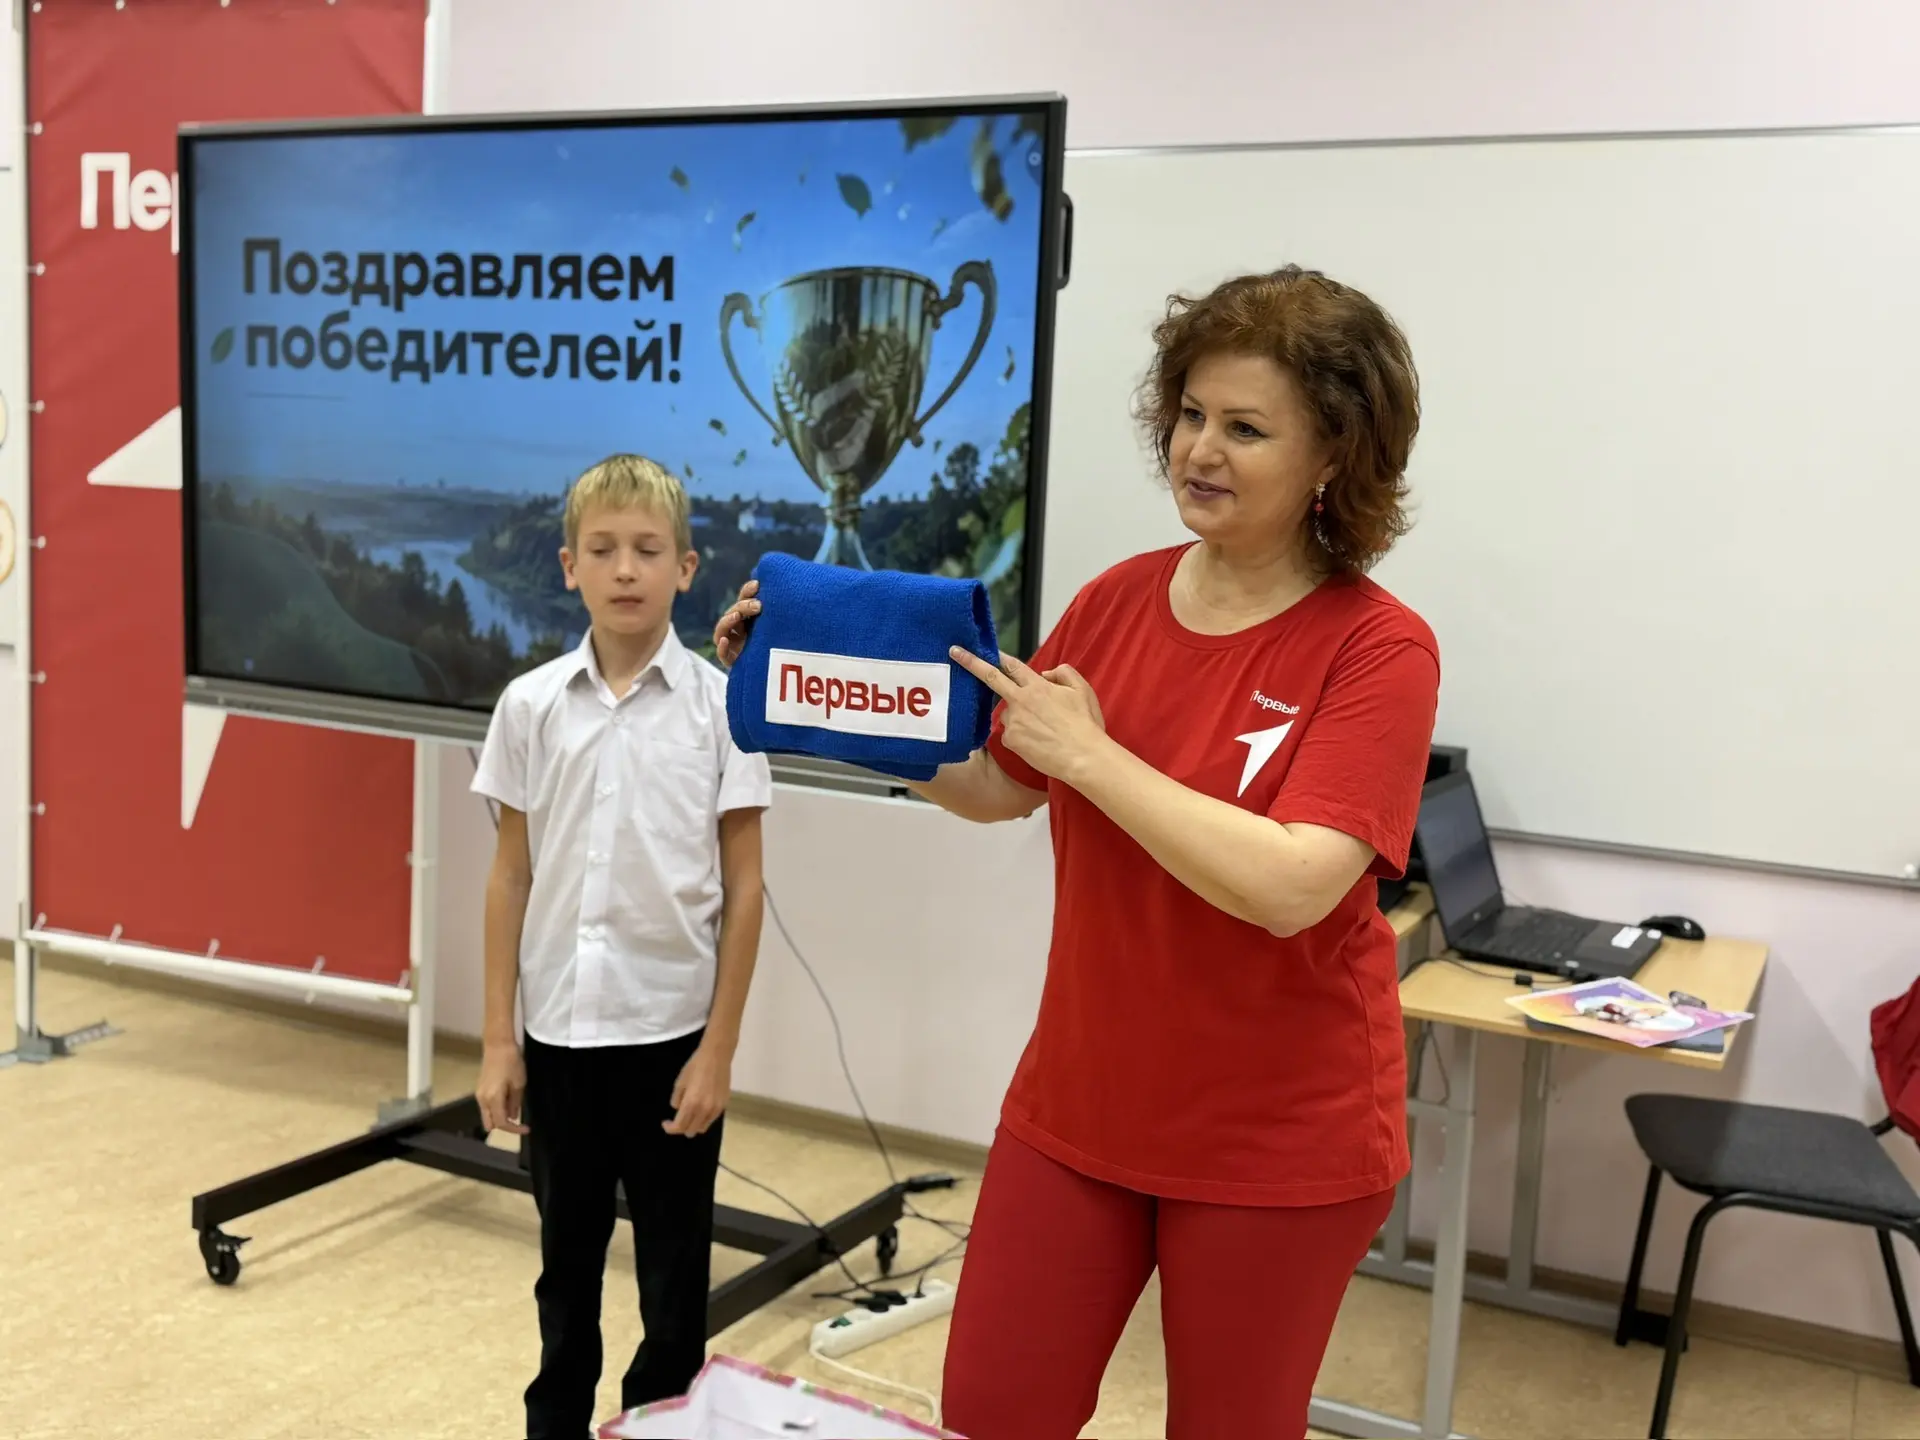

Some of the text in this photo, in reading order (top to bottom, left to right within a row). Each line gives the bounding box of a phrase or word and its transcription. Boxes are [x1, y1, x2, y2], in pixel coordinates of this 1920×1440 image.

[80, 151, 179, 255] Пе
[243, 237, 674, 312] Поздравляем
[245, 310, 682, 384] победителей!
[779, 663, 932, 719] Первые
[1249, 689, 1301, 715] Первые
